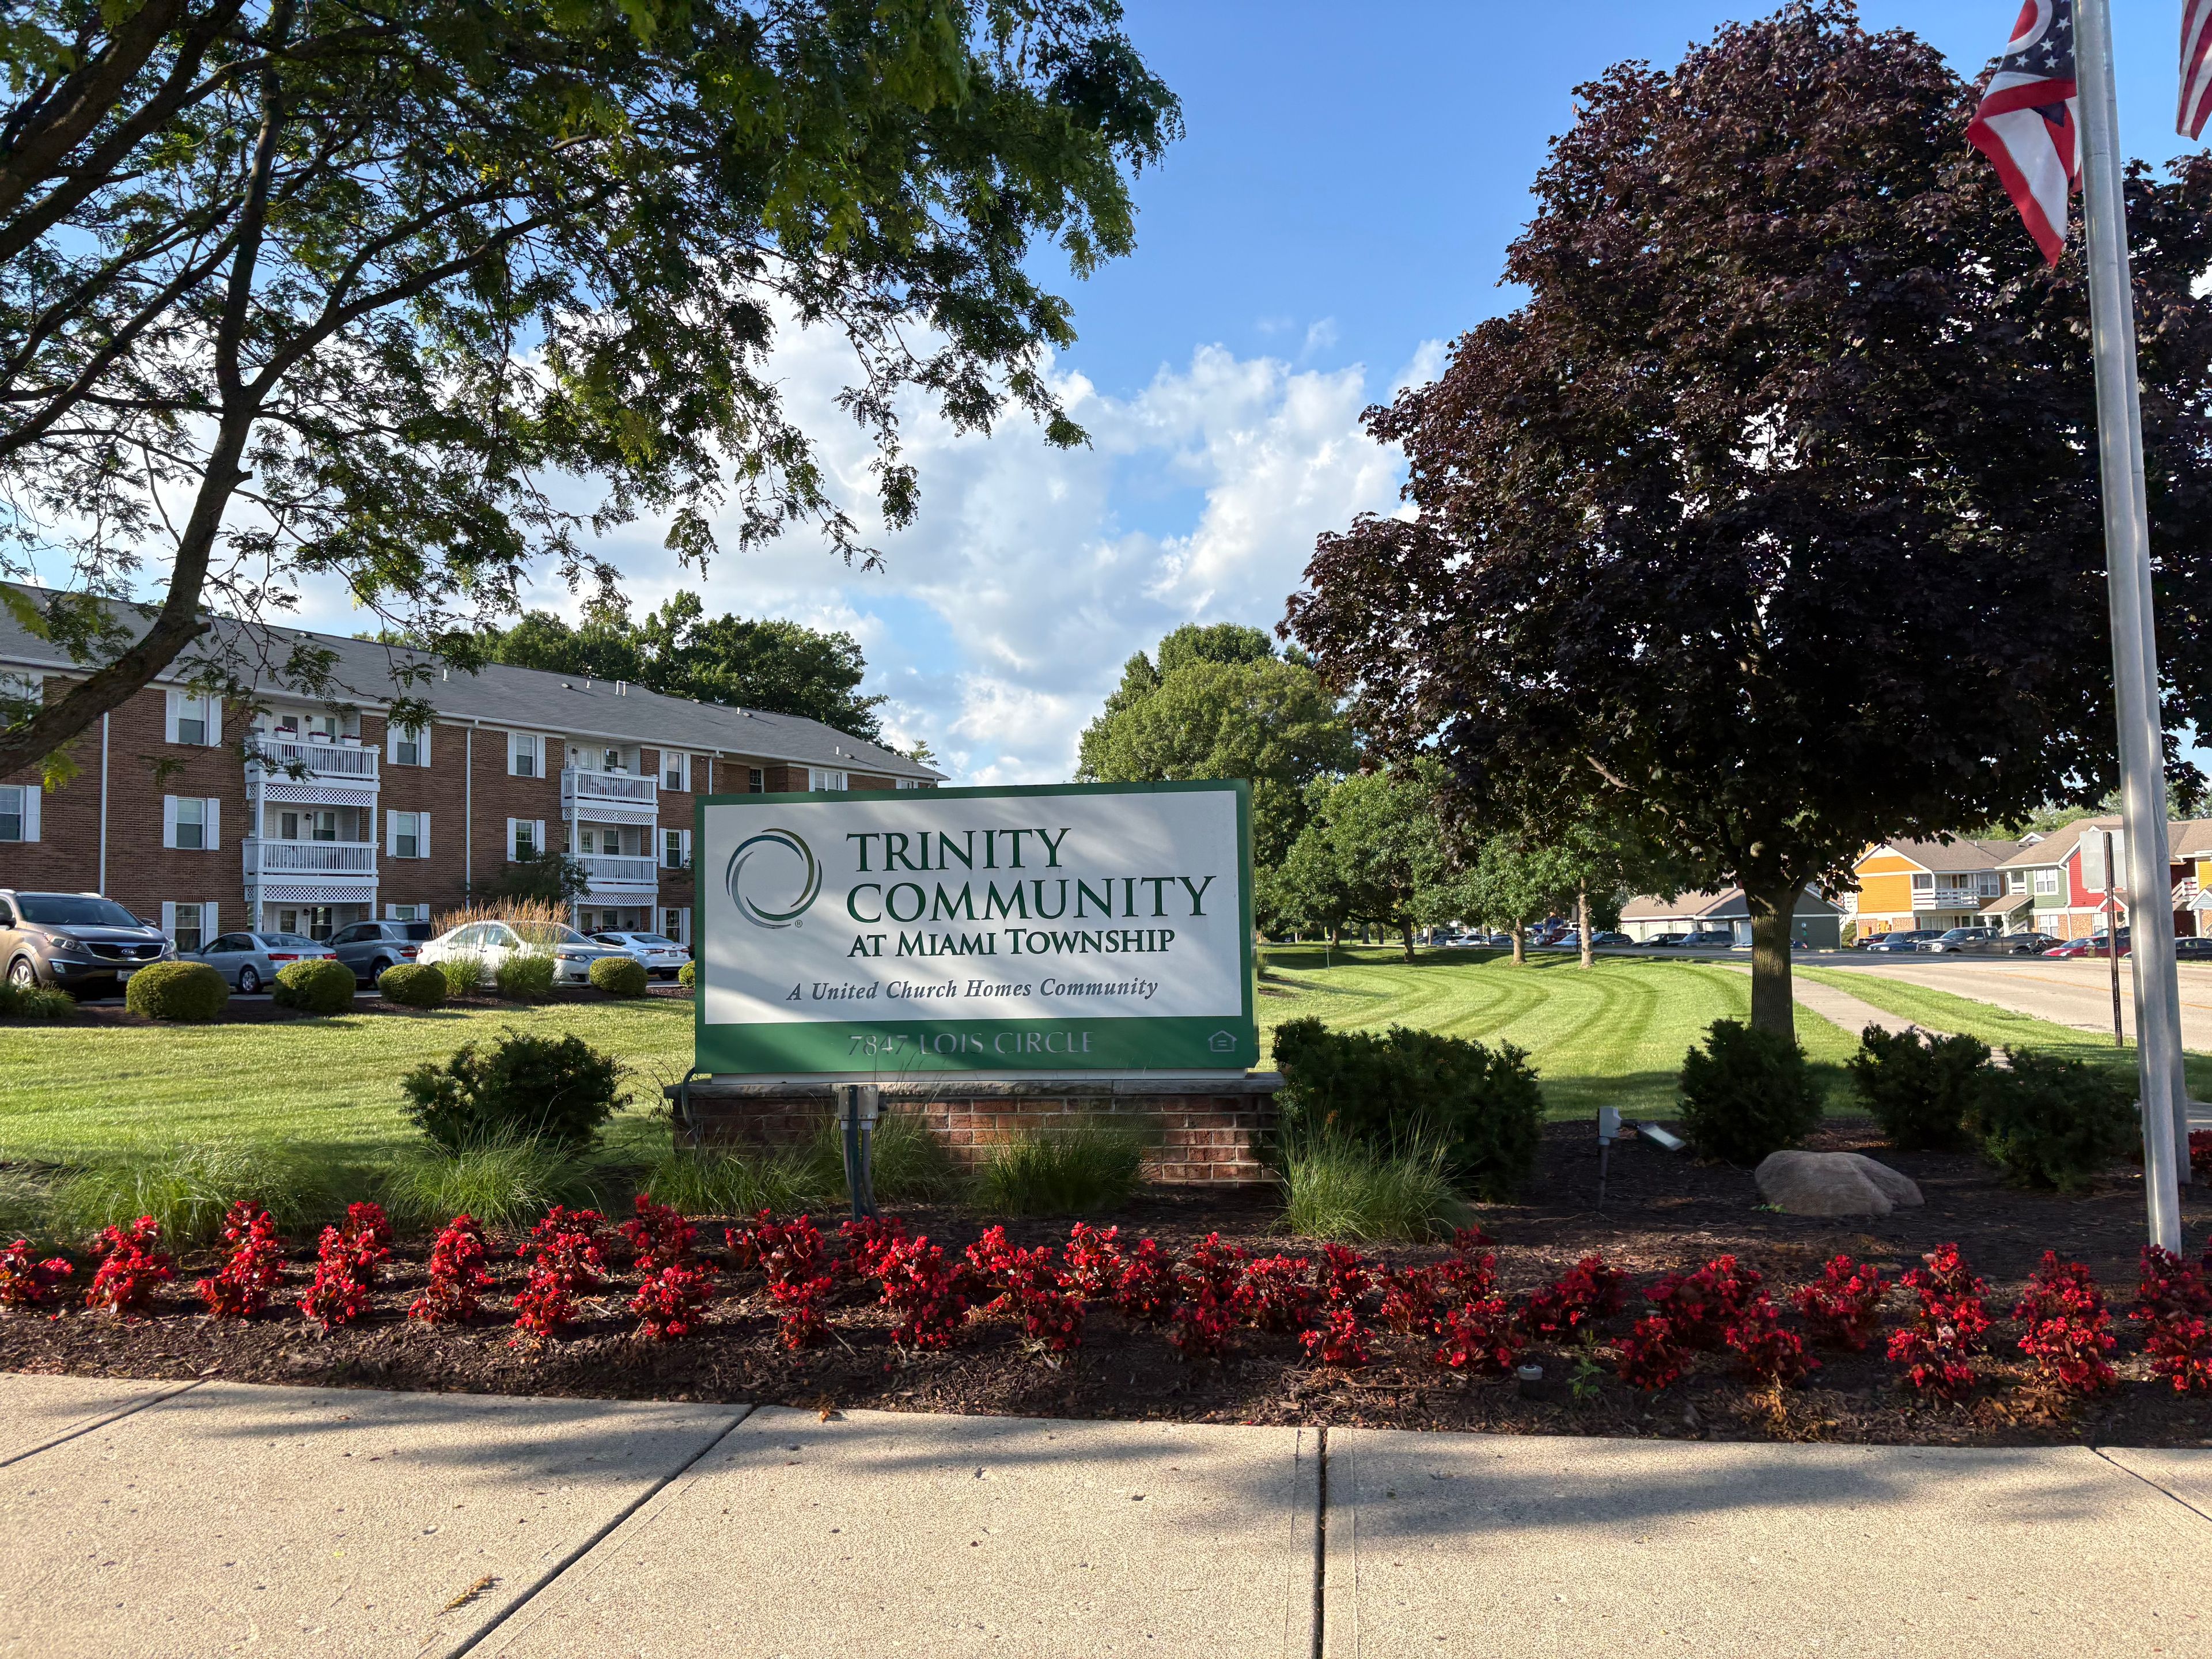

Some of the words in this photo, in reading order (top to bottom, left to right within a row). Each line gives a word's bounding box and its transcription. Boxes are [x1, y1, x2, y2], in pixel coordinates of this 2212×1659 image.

[846, 828, 1071, 871] TRINITY
[847, 876, 1216, 923] COMMUNITY
[847, 934, 887, 957] AT
[895, 930, 997, 956] MIAMI
[1004, 928, 1175, 954] TOWNSHIP
[786, 983, 802, 1001] A
[812, 981, 879, 1000] United
[886, 979, 957, 999] Church
[964, 979, 1032, 997] Homes
[1040, 978, 1158, 999] Community
[849, 1035, 908, 1055] 7847
[919, 1033, 984, 1054] LOIS
[994, 1032, 1094, 1054] CIRCLE
